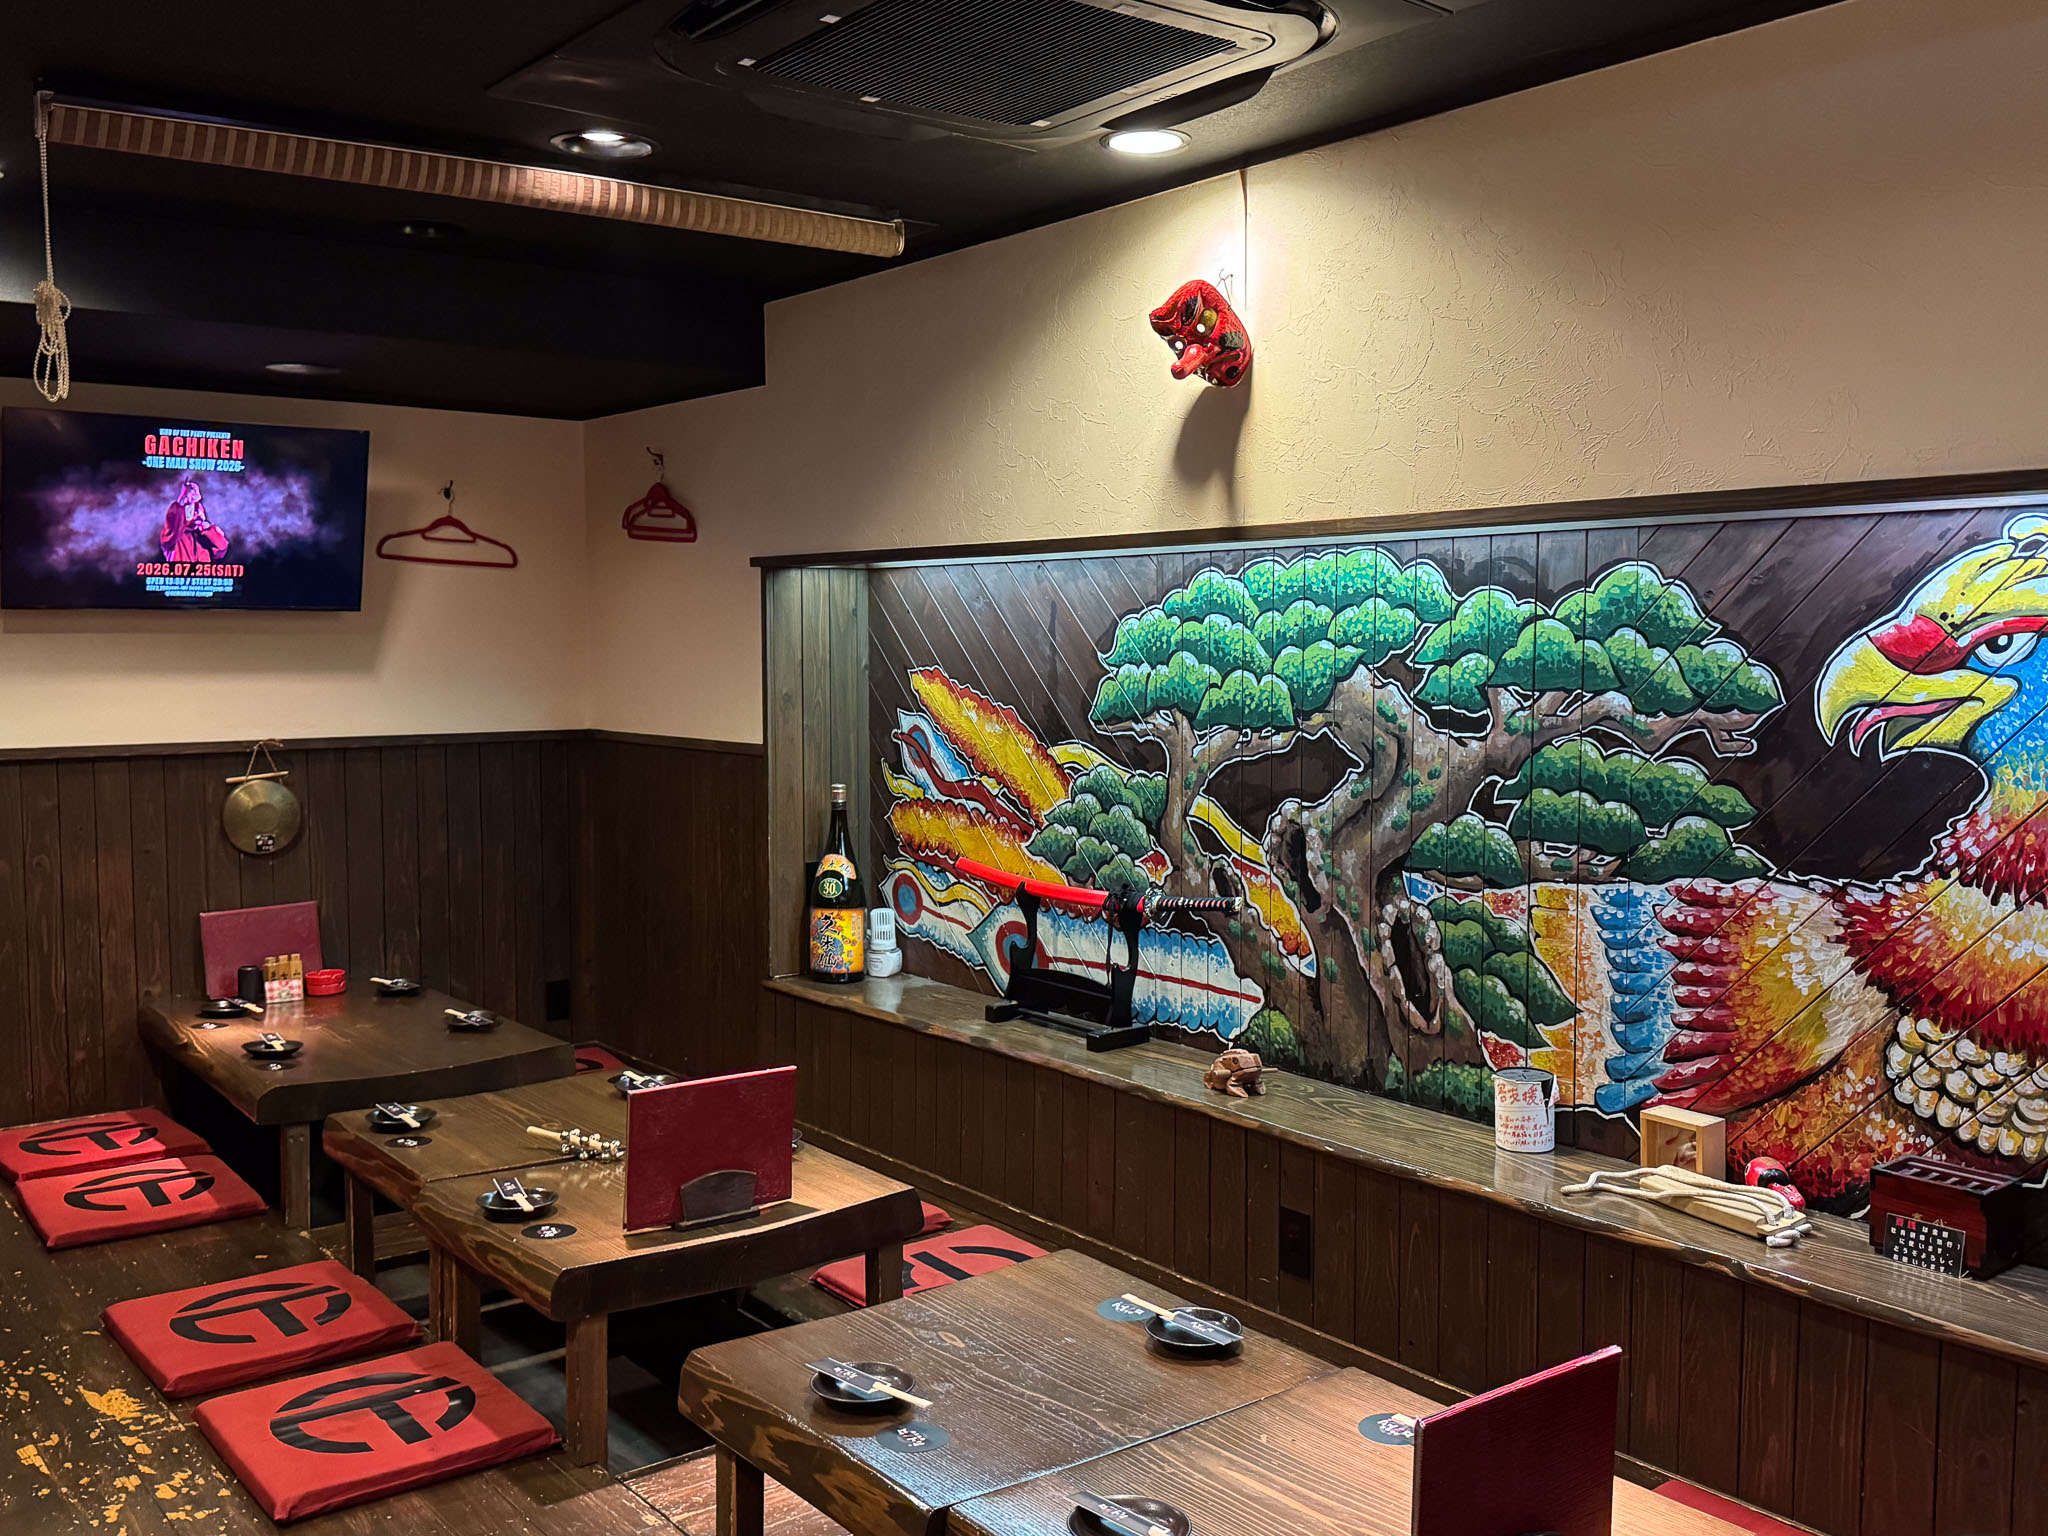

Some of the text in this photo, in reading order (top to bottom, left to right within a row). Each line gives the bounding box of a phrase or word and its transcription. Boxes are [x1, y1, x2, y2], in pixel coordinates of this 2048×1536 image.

[144, 434, 244, 459] GACHIKEN
[165, 457, 188, 470] MAN
[188, 458, 217, 471] SHOW
[136, 562, 244, 577] 2026.07.25(SAT)
[818, 912, 840, 968] 久米仙
